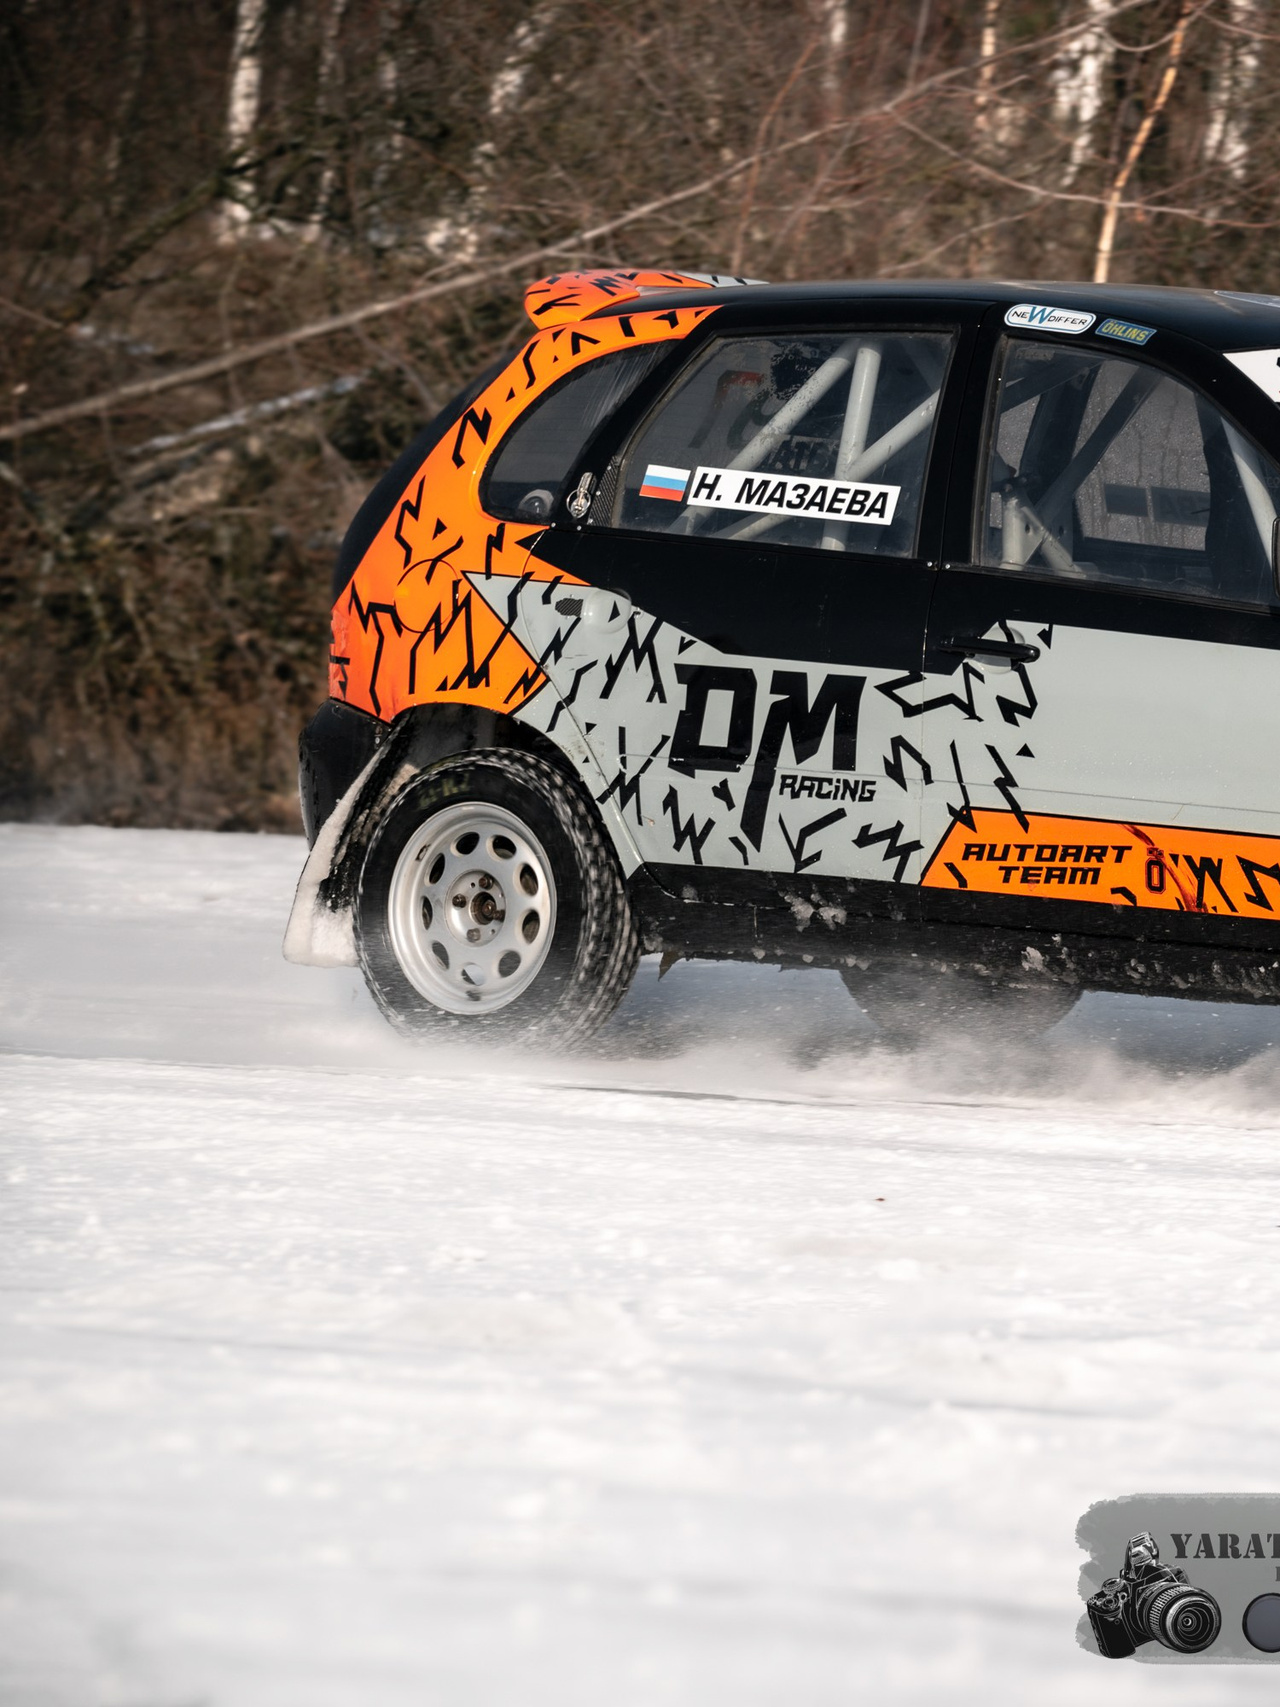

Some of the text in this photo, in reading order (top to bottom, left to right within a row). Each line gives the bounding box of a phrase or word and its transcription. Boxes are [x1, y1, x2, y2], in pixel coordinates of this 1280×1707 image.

[692, 472, 890, 519] Н. МАЗАЕВА
[667, 662, 868, 853] DM
[961, 843, 1134, 864] AUTOART
[997, 865, 1102, 886] TEAM
